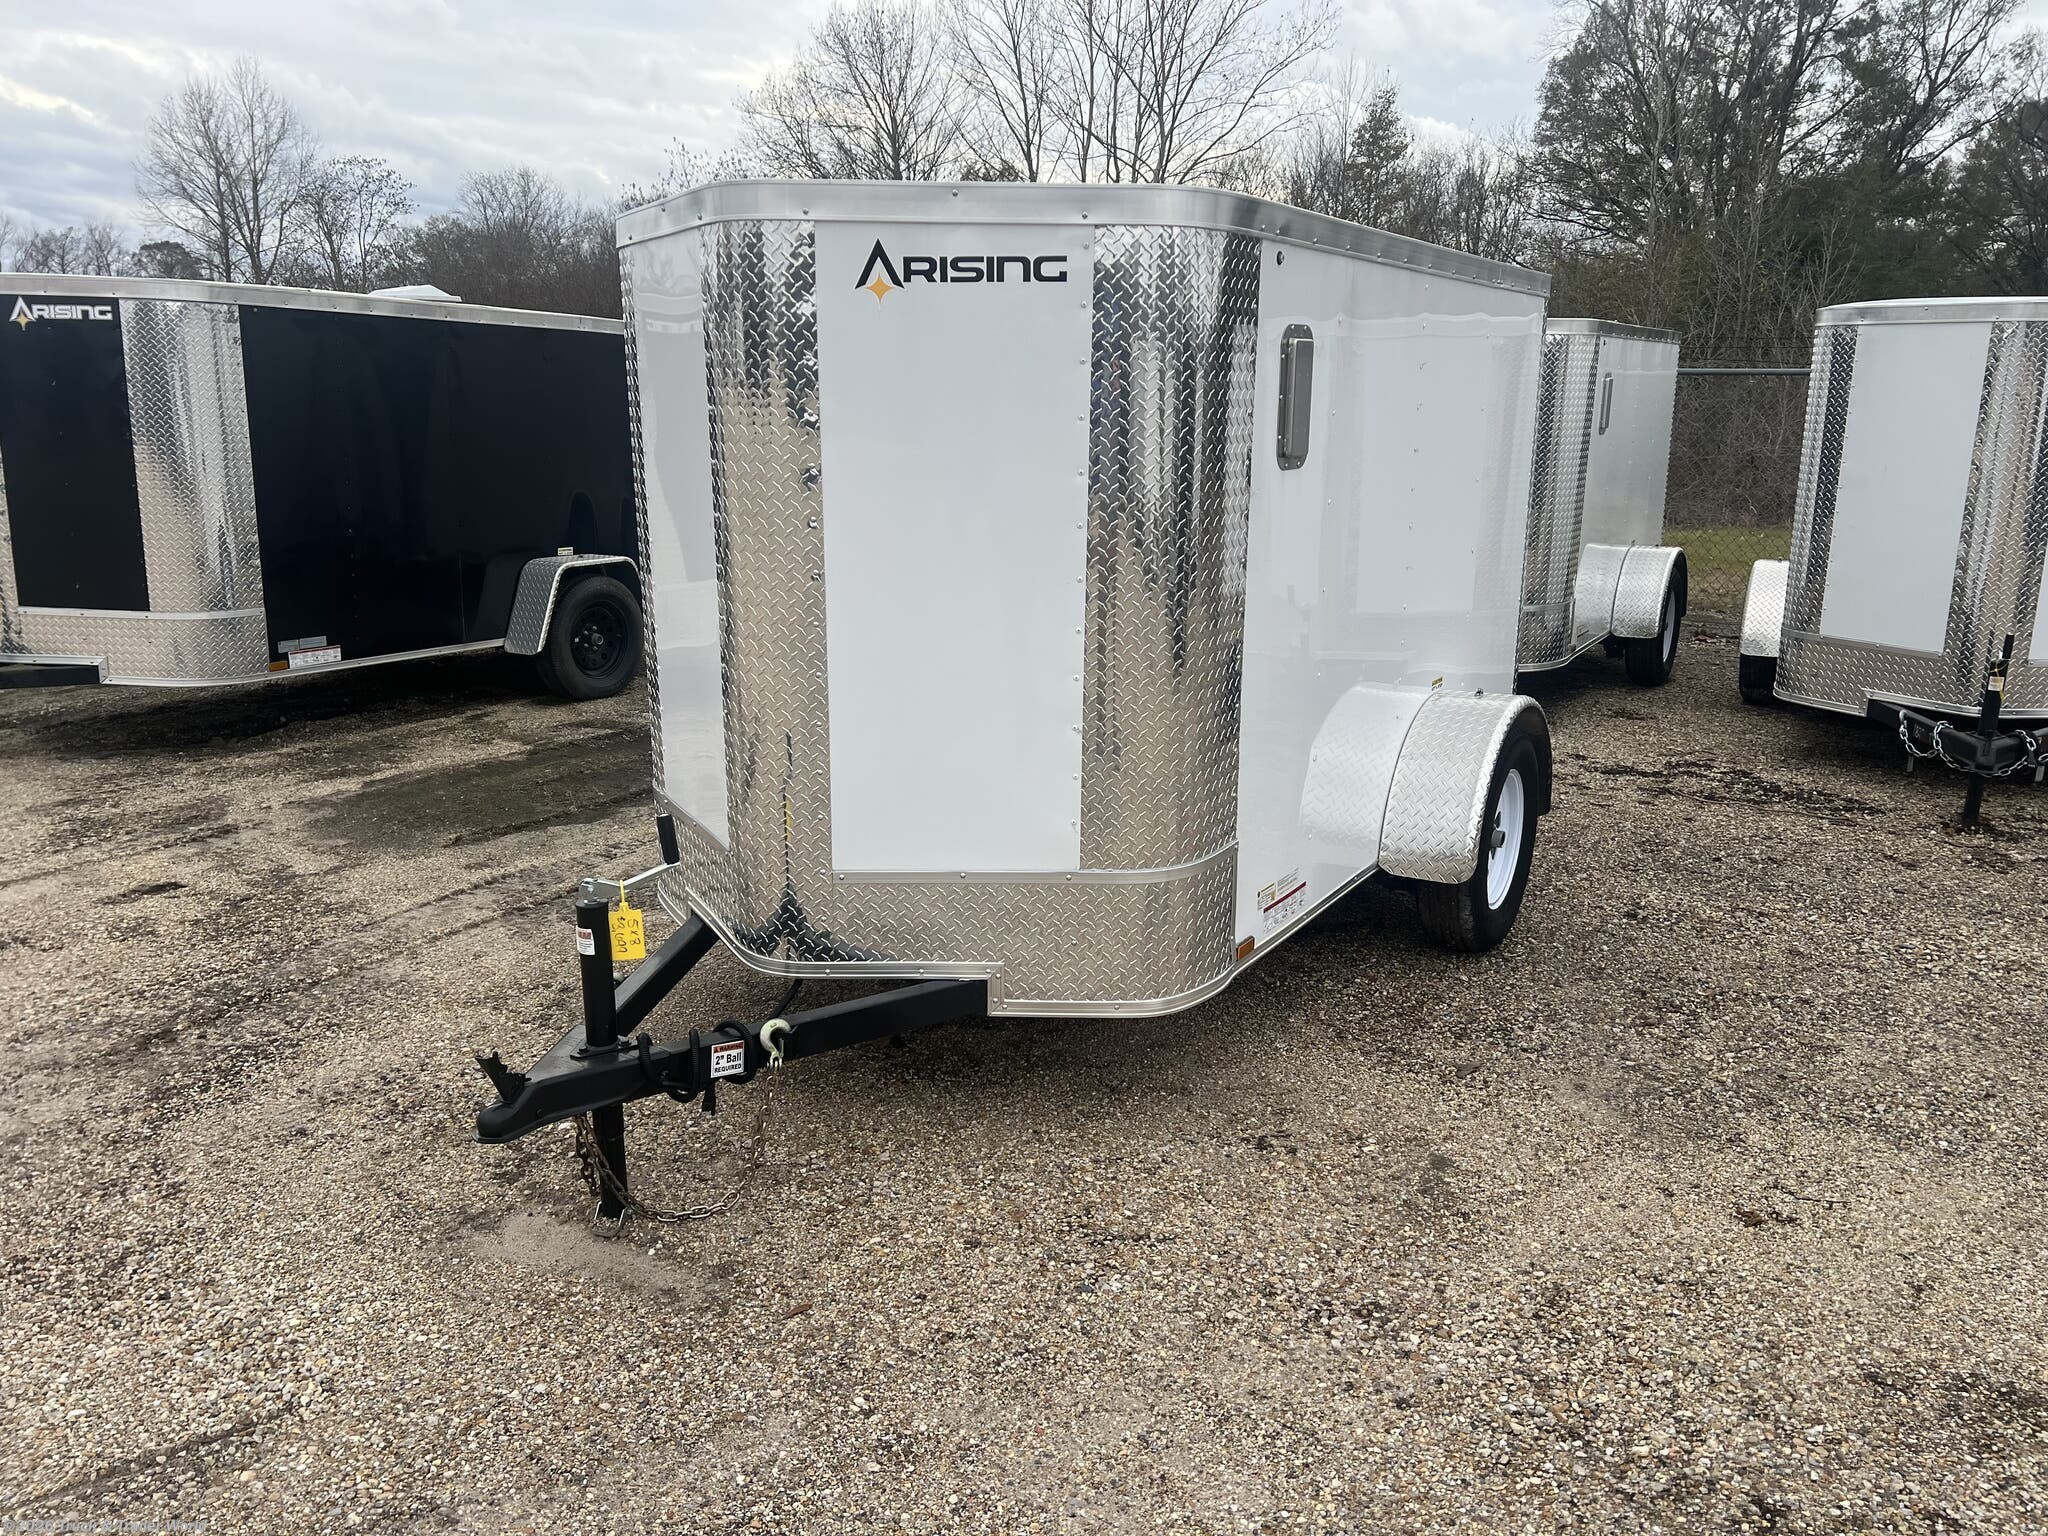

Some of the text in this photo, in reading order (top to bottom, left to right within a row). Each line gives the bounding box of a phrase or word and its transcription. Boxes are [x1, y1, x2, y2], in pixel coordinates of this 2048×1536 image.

[855, 238, 1067, 290] ARISING
[9, 296, 113, 322] ARISING
[727, 1052, 742, 1063] Ball
[714, 1063, 742, 1073] REQUIRED
